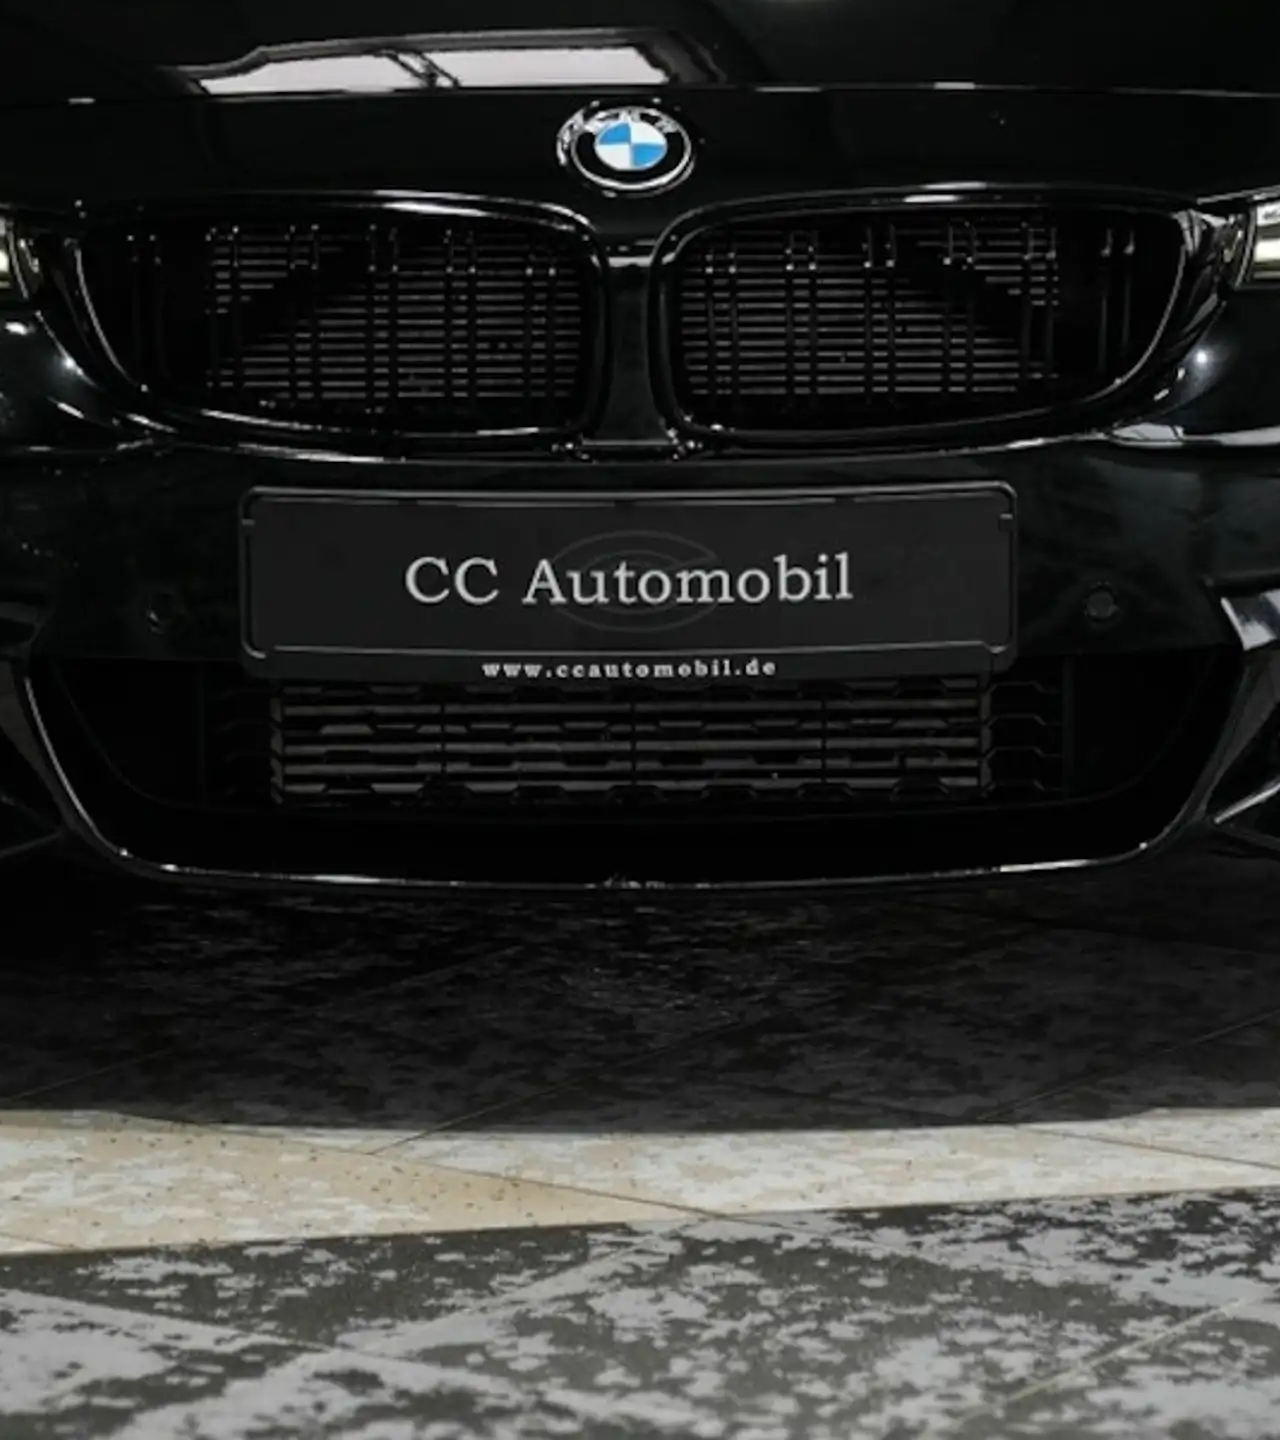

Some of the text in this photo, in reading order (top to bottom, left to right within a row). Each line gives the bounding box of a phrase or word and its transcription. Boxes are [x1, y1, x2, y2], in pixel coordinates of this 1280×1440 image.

[405, 551, 854, 606] CC Automobil
[481, 657, 776, 679] www.ccautomobil.de
